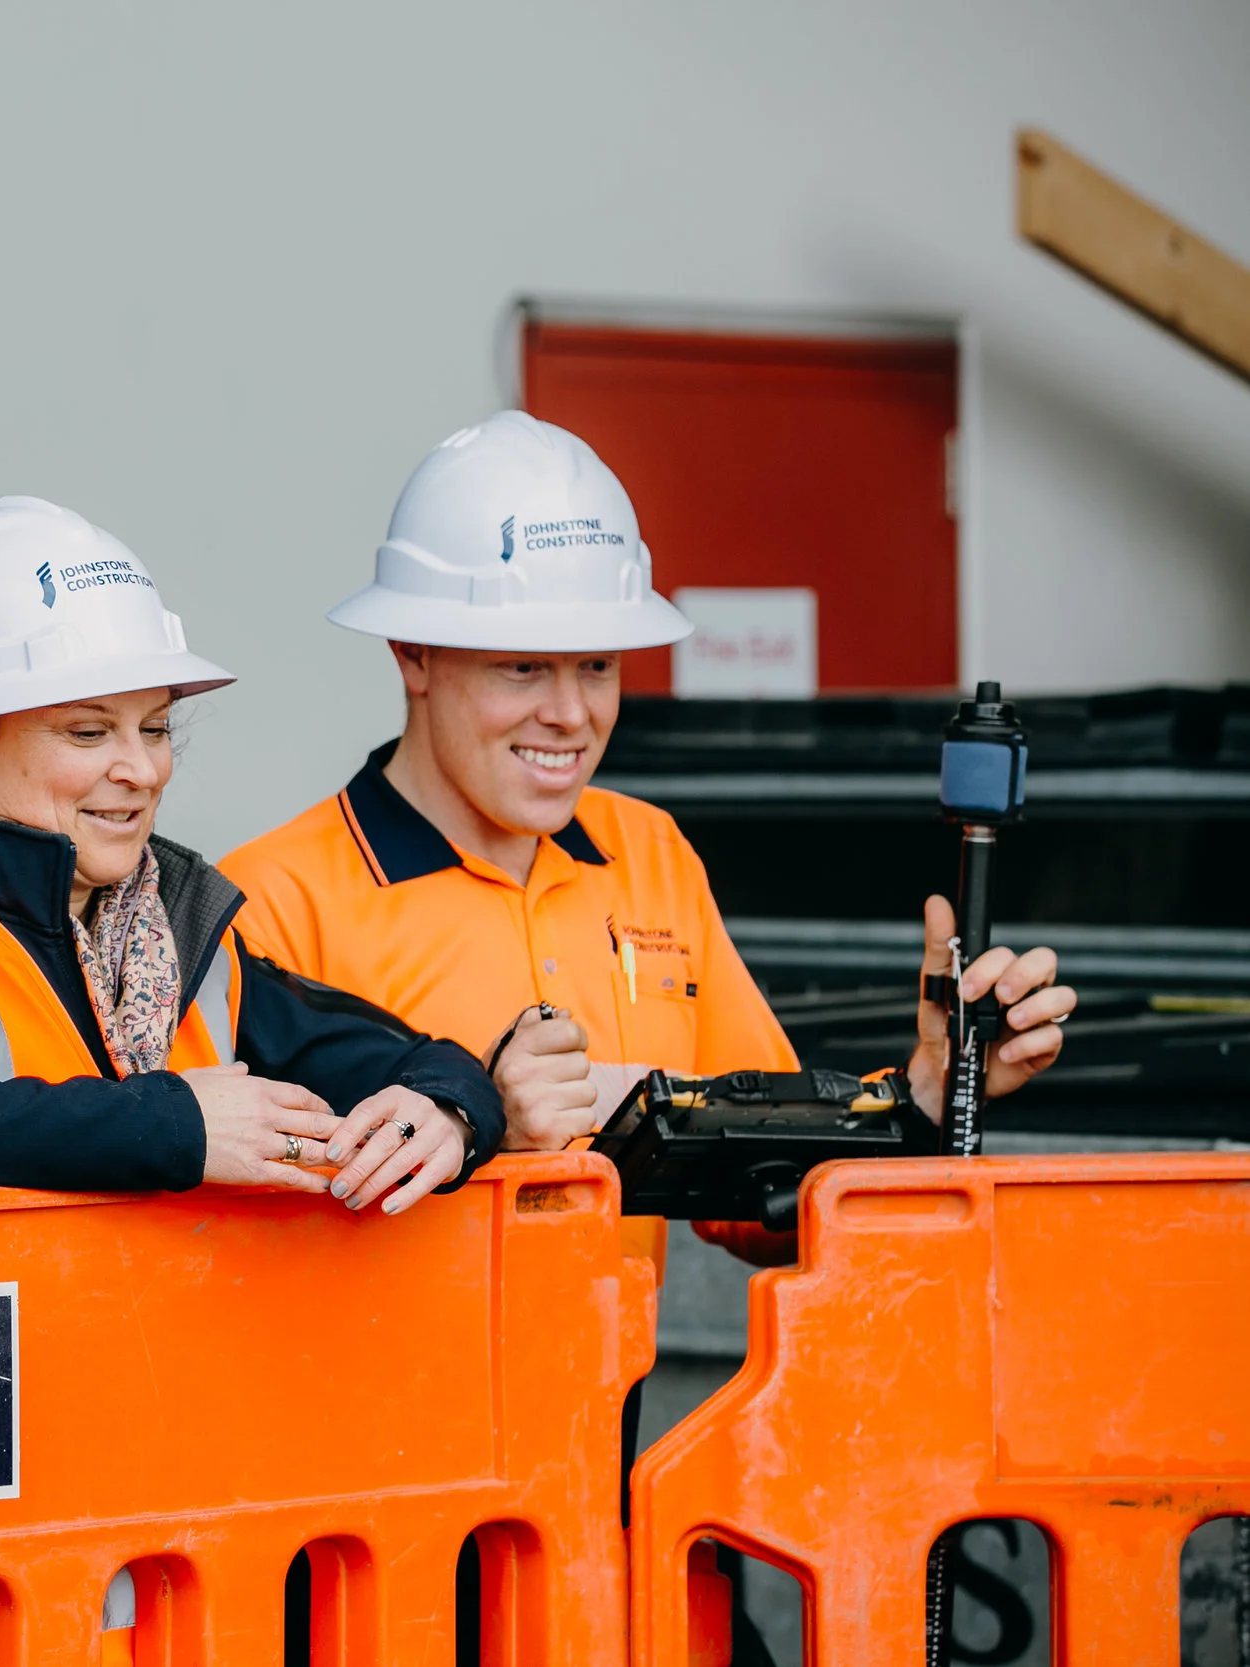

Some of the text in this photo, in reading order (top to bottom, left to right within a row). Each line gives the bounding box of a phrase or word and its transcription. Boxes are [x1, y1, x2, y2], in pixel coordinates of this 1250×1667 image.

[524, 519, 601, 538] JOHNSTONE
[526, 533, 625, 551] CONSTRUCTION
[59, 560, 133, 582] JOHNSTONE
[66, 573, 156, 592] CONSTRUCTION
